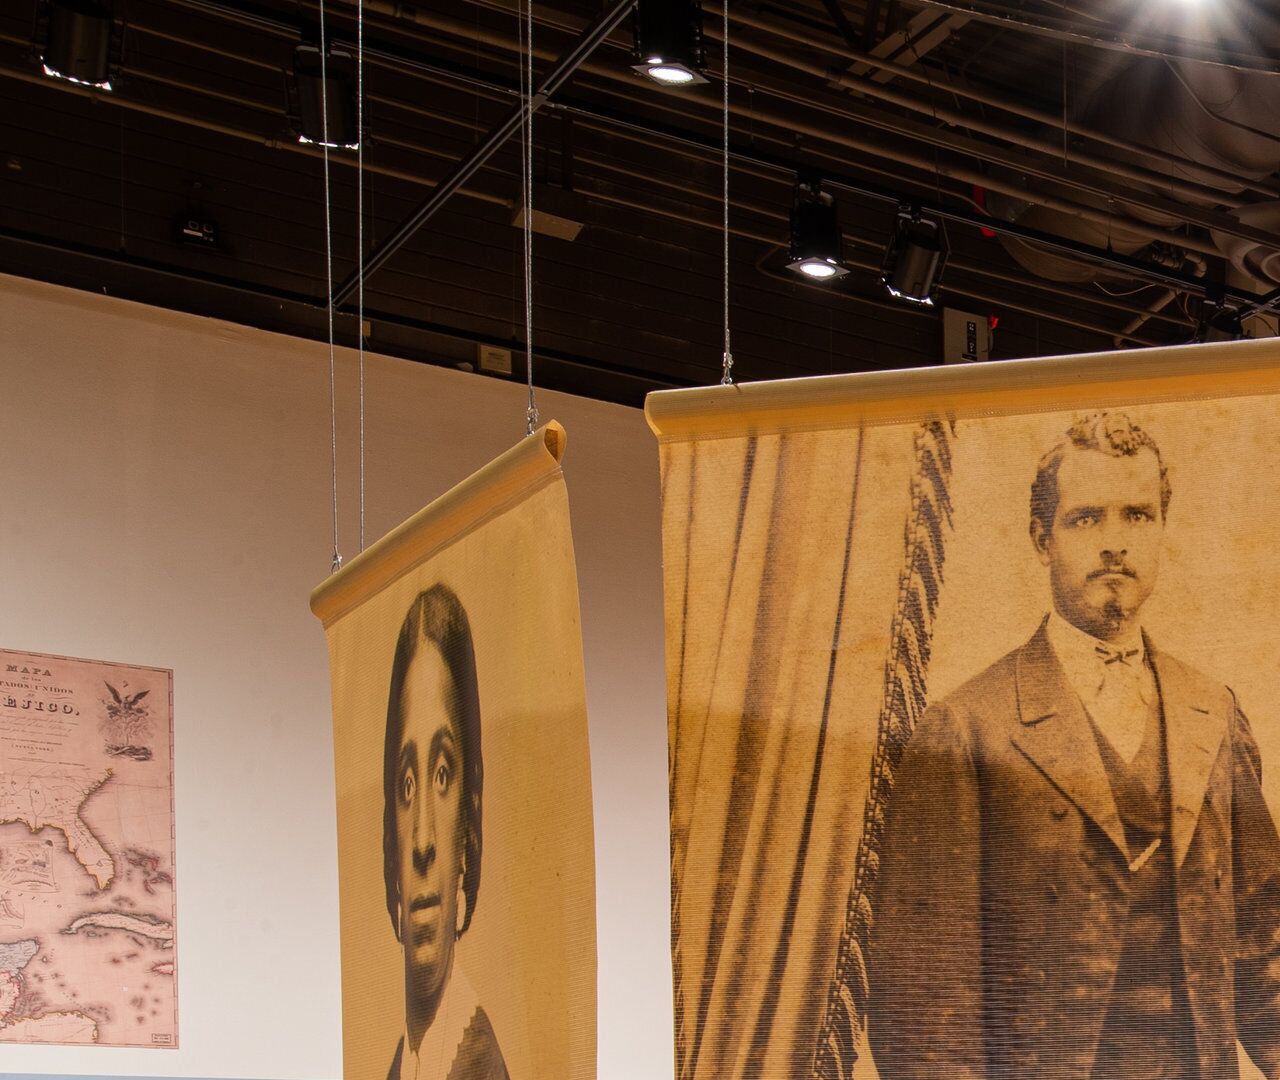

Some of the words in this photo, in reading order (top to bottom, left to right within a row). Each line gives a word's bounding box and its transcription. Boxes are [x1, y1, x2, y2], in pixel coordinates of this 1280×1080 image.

[6, 664, 52, 677] MAPA
[0, 680, 30, 690] TADOS
[3, 695, 80, 716] ÉJICO,
